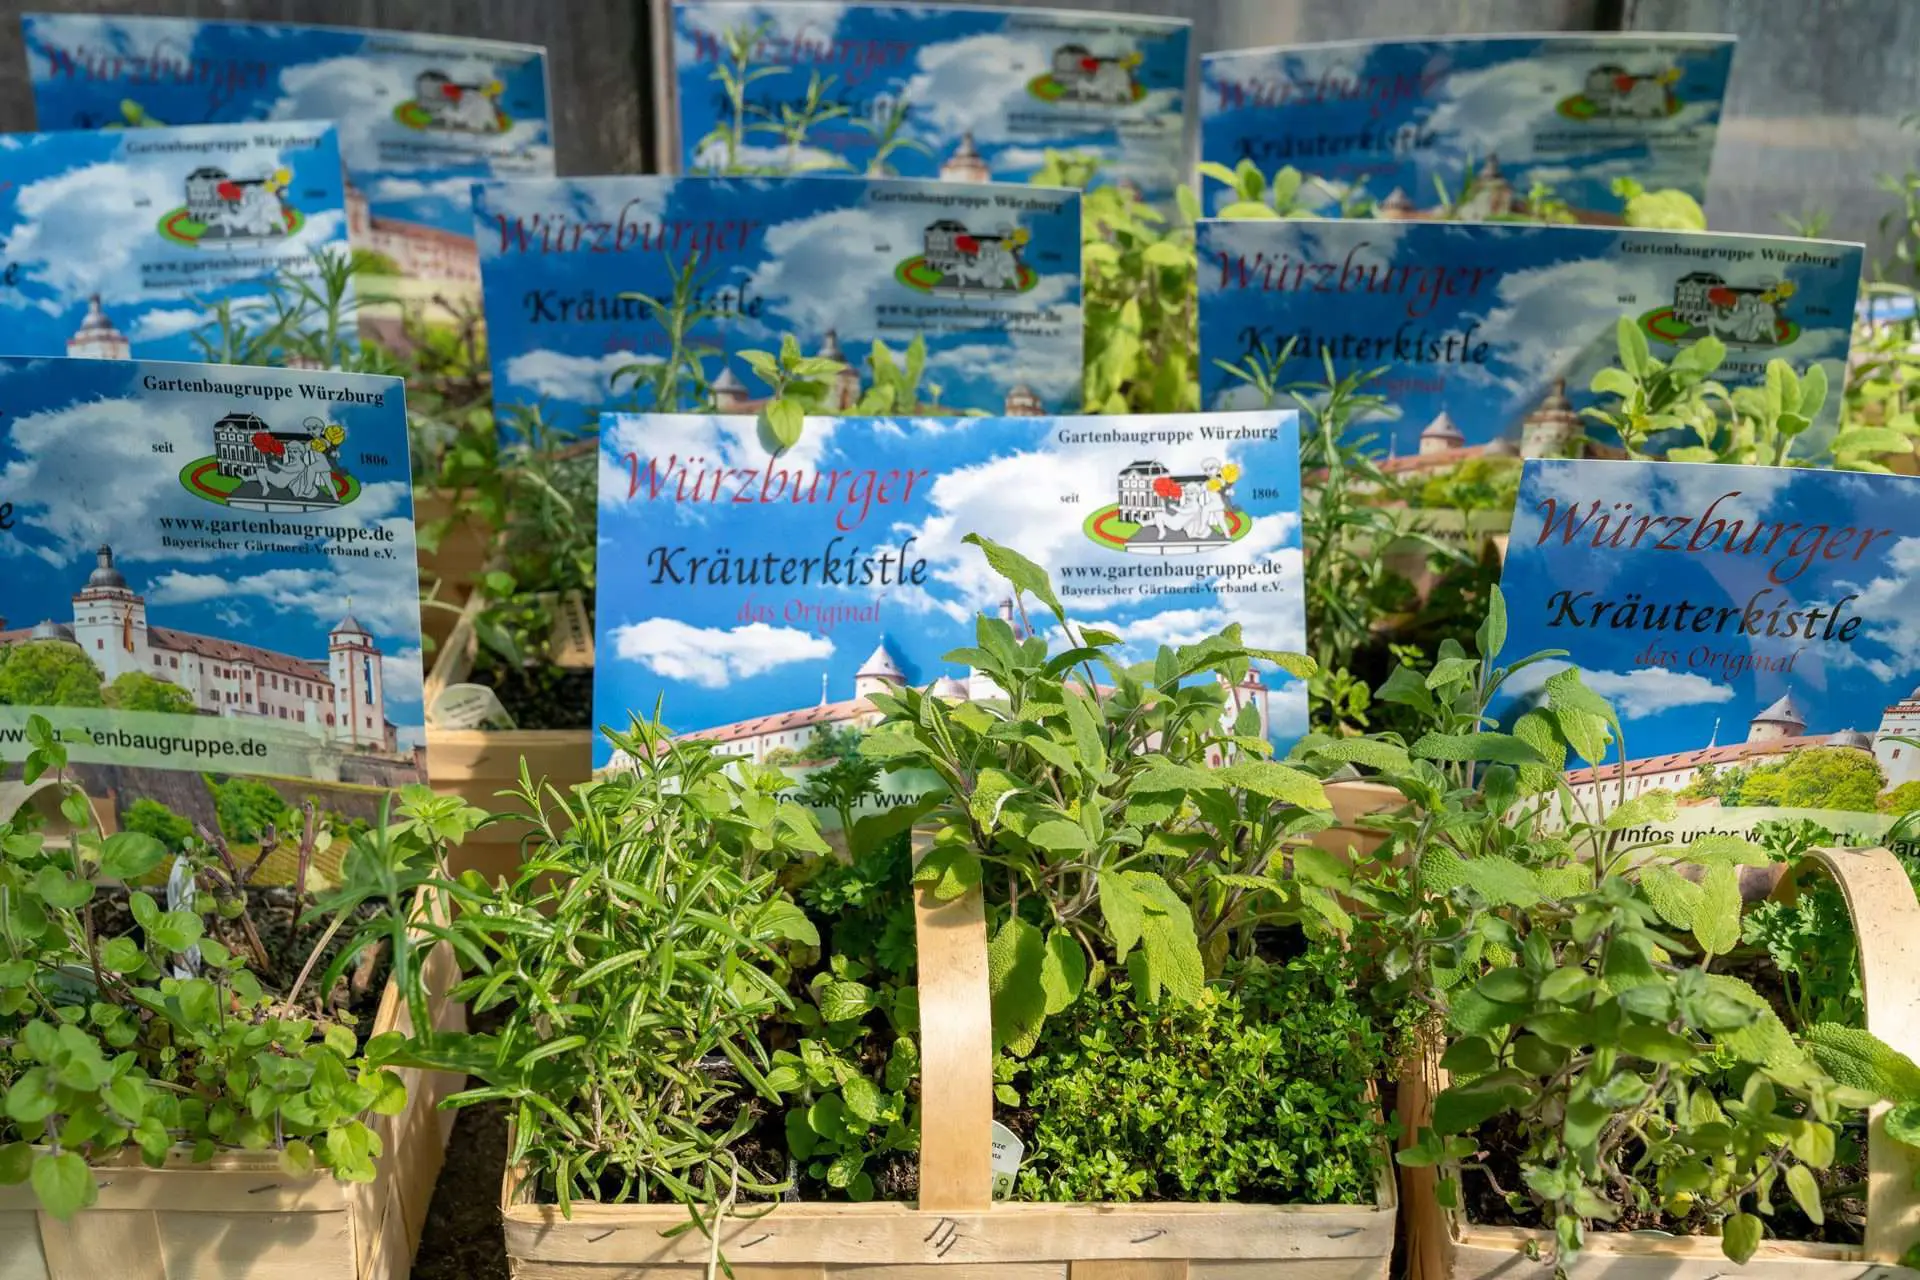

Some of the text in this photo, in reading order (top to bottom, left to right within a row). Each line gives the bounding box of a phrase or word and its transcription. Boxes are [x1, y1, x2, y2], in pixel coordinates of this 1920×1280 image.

[495, 198, 760, 274] Würzburger
[1621, 240, 1840, 269] Gartenbaugruppe Würzburg
[1216, 241, 1495, 318] Würzburger
[143, 374, 385, 408] Gartenbaugruppe Würzburg
[151, 440, 174, 454] seit
[1058, 426, 1279, 446] Gartenbaugruppe Würzburg
[359, 452, 389, 467] 1806
[620, 445, 929, 532] Würzburger
[1060, 493, 1080, 504] seit
[1251, 487, 1280, 500] 1806
[159, 517, 395, 543] www.gartenbaugruppe.de
[1535, 490, 1895, 586] Würzburger
[161, 536, 397, 560] Bayerischer Gärtnerei-Verband e.V.
[647, 536, 929, 586] Kräuterkistle
[1060, 559, 1283, 579] www.gartenbaugruppe.de
[1060, 582, 1284, 597] Bayerischer Gärtnerei-Verband e.V.
[736, 592, 888, 635] das Original
[1545, 588, 1864, 643] Kräuterkistle
[1634, 638, 1805, 681] das Original
[1619, 824, 1675, 844] Infos
